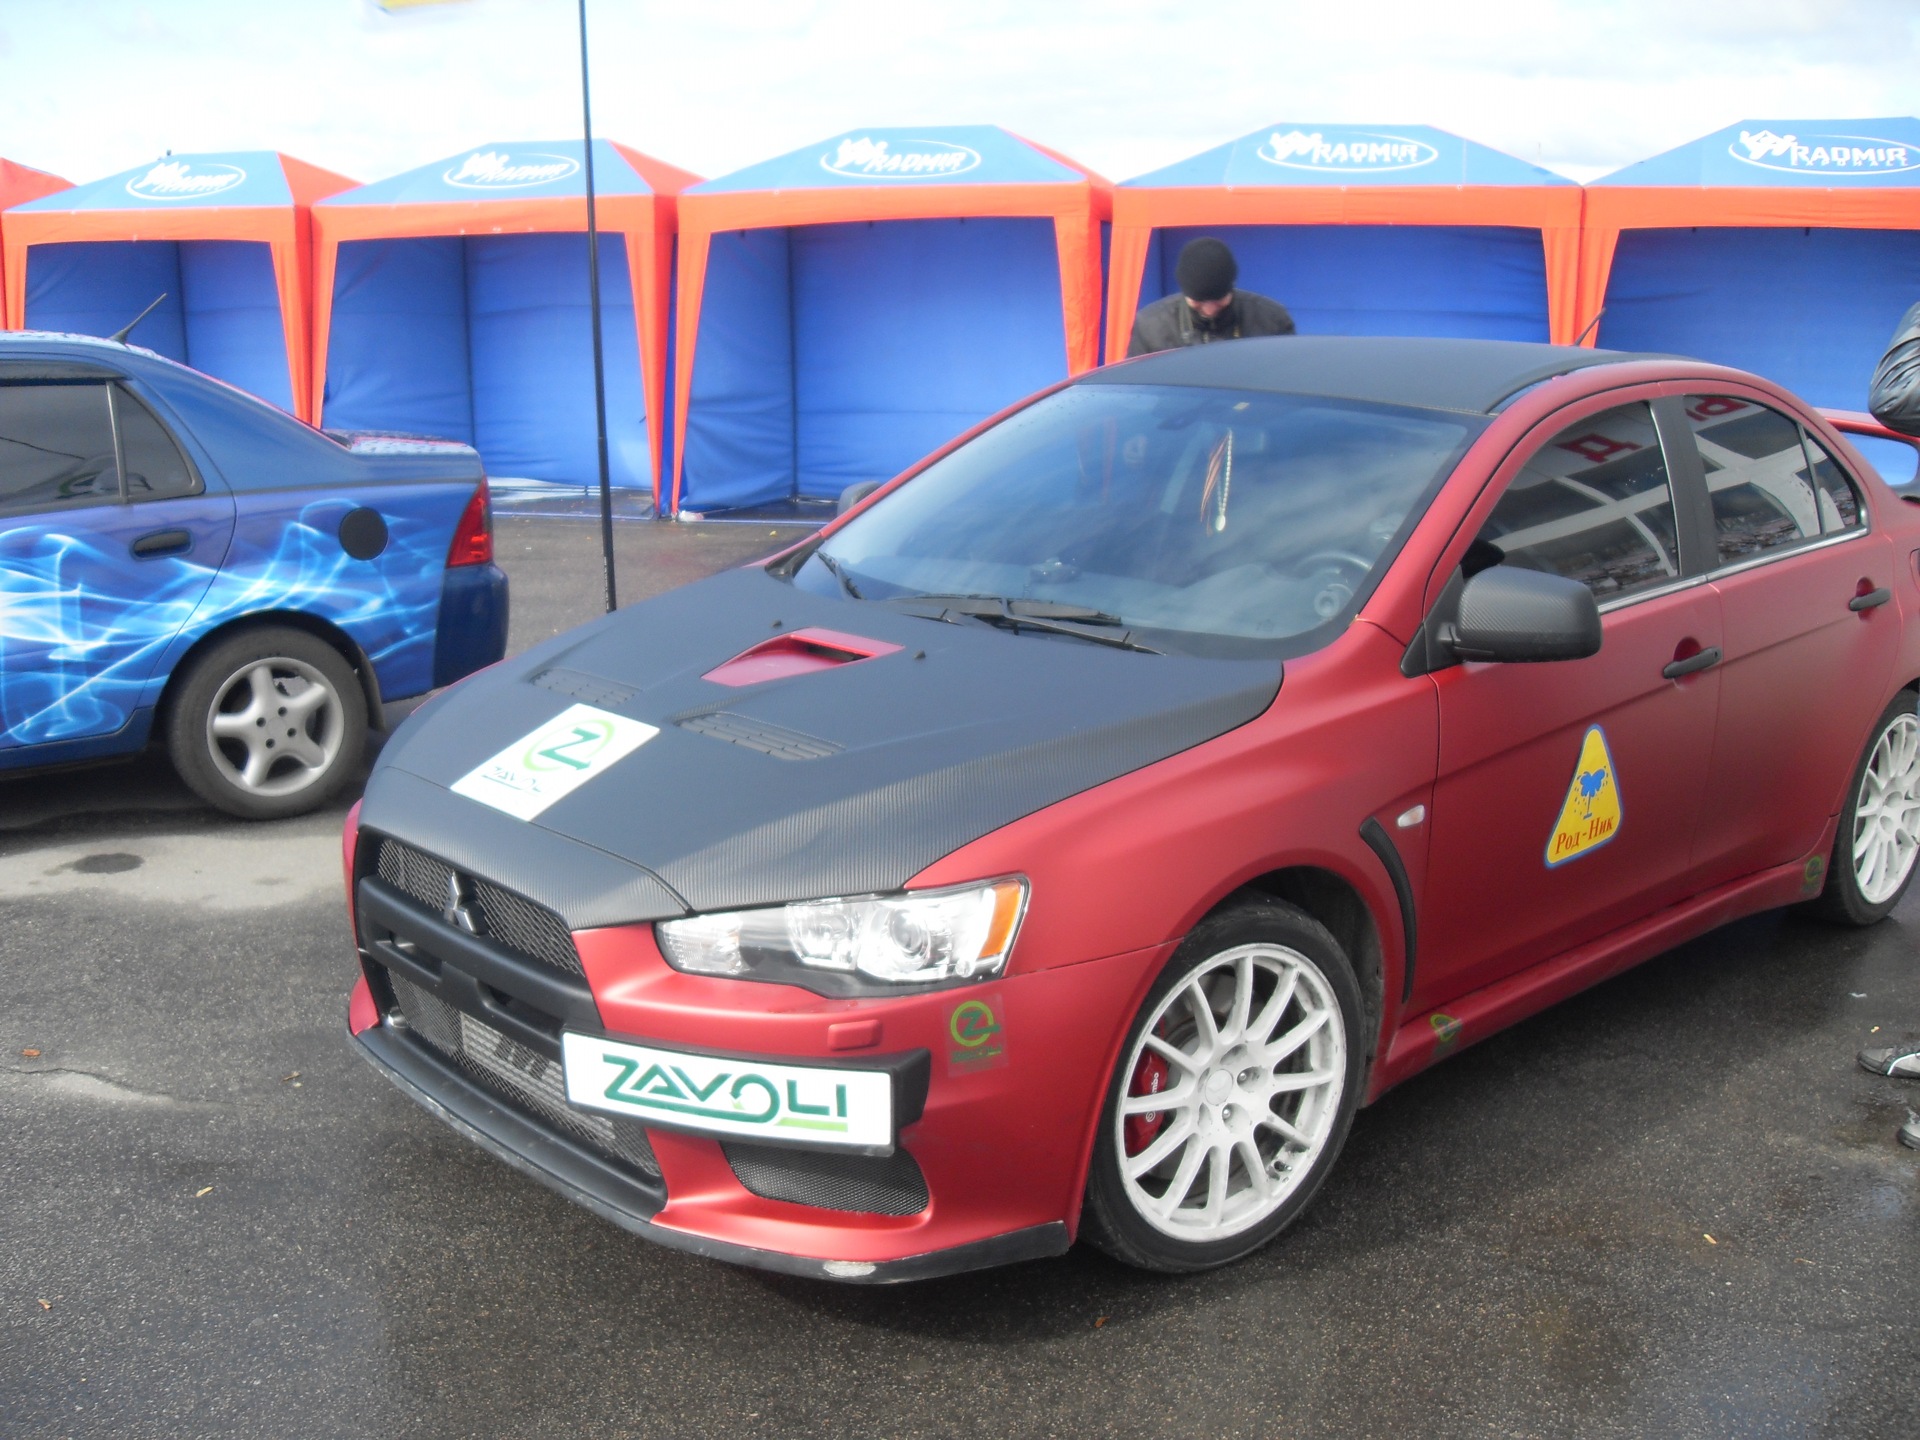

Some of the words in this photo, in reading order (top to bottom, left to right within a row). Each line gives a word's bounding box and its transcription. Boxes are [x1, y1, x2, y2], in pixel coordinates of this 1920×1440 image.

[863, 152, 967, 172] RADMIR
[1312, 143, 1418, 162] RADMIR
[1790, 145, 1907, 164] RADMIR
[1555, 815, 1615, 854] Род-Ник
[602, 1053, 848, 1124] ZAVOLI
